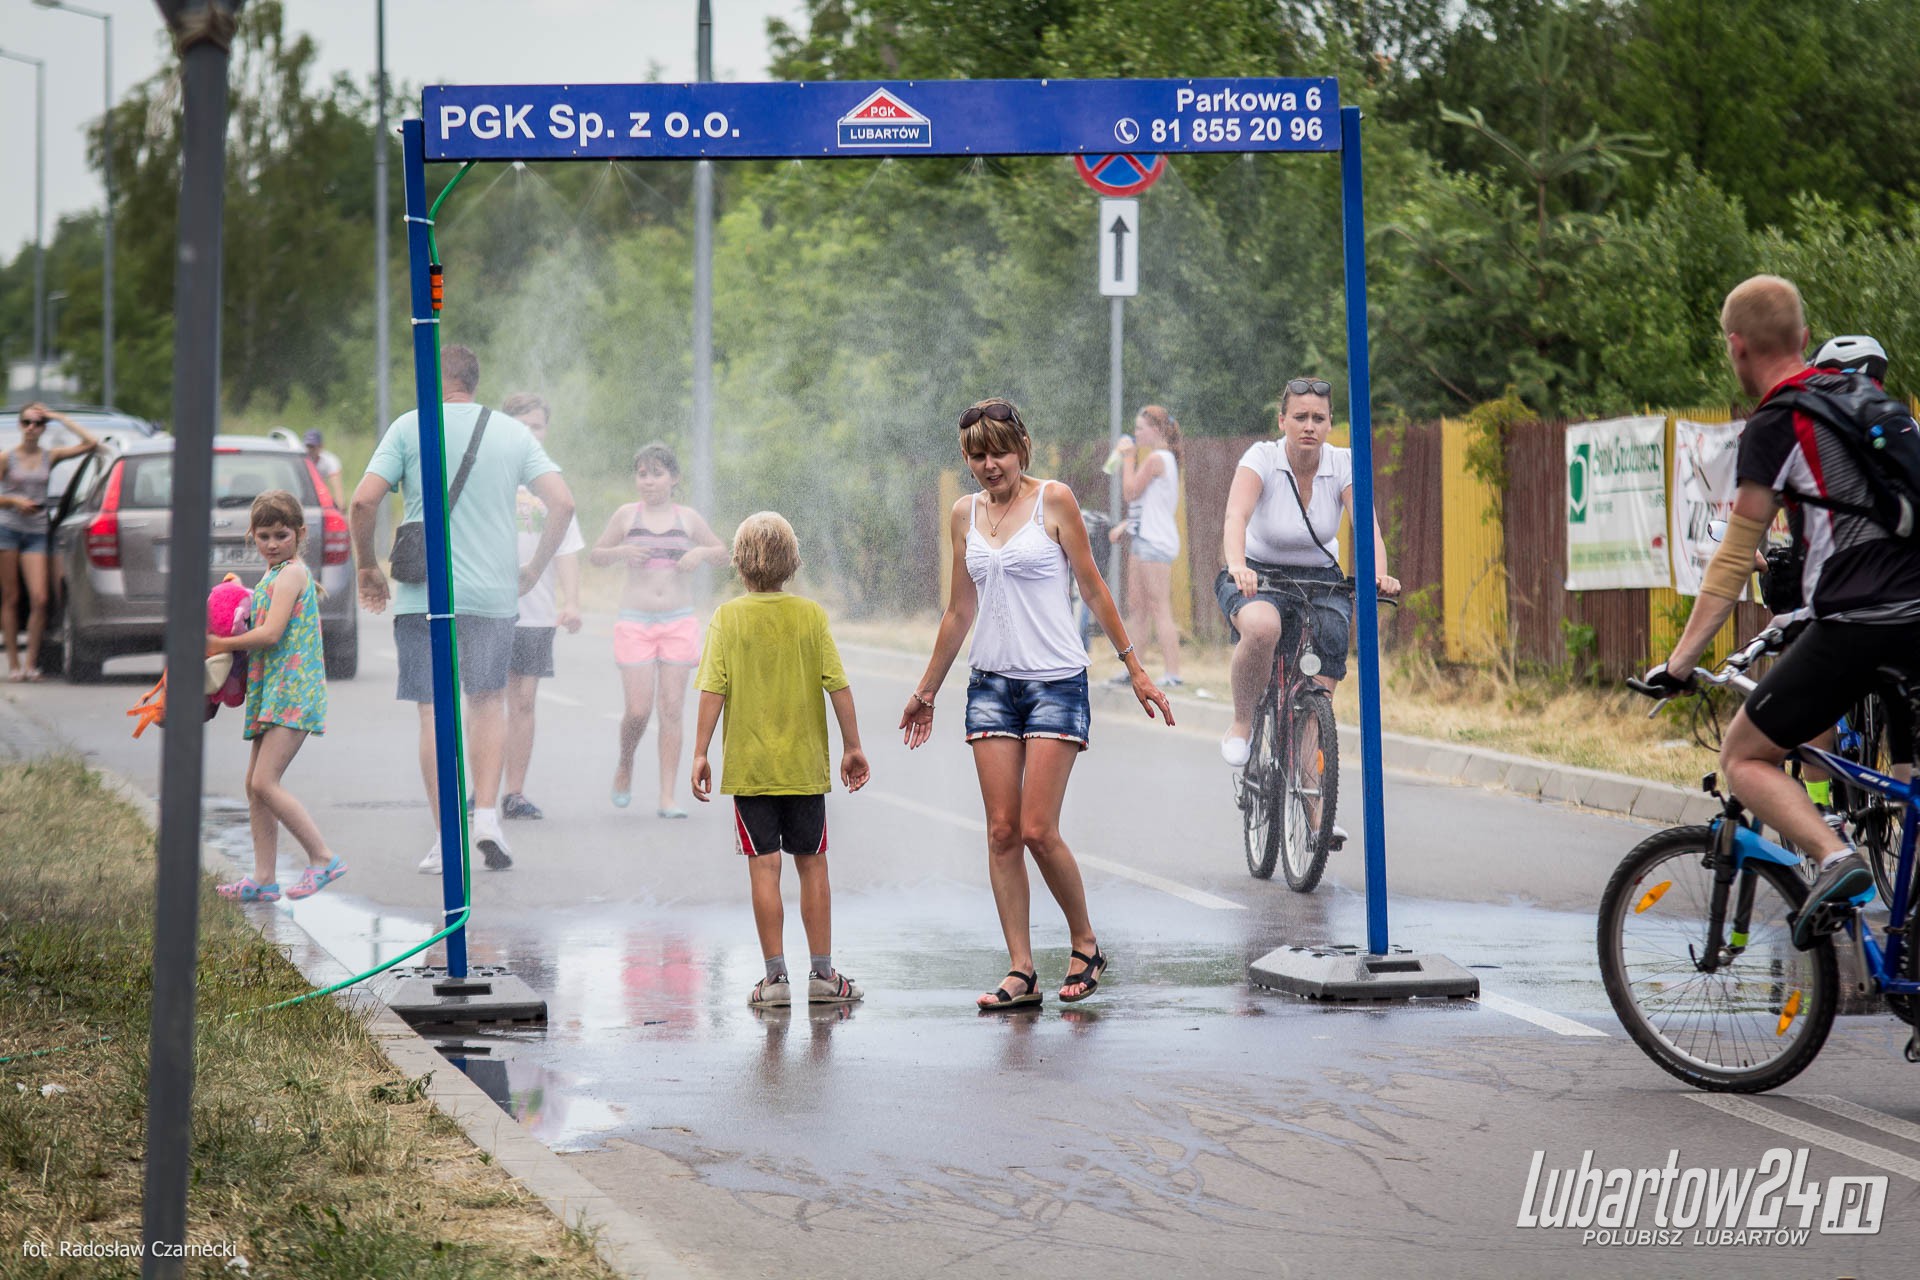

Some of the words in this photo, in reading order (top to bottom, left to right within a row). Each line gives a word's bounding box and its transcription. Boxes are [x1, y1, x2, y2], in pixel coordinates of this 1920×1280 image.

[870, 106, 896, 117] PGK
[1177, 88, 1297, 112] Parkowa
[1305, 86, 1322, 110] 6
[440, 104, 536, 140] PGK
[549, 104, 615, 147] Sp.
[629, 112, 652, 138] z
[664, 112, 740, 139] o.o.
[850, 126, 920, 140] LUBARTÓW
[1151, 118, 1180, 143] 81
[1192, 118, 1241, 142] 855
[1249, 117, 1282, 142] 20
[1290, 116, 1323, 141] 96
